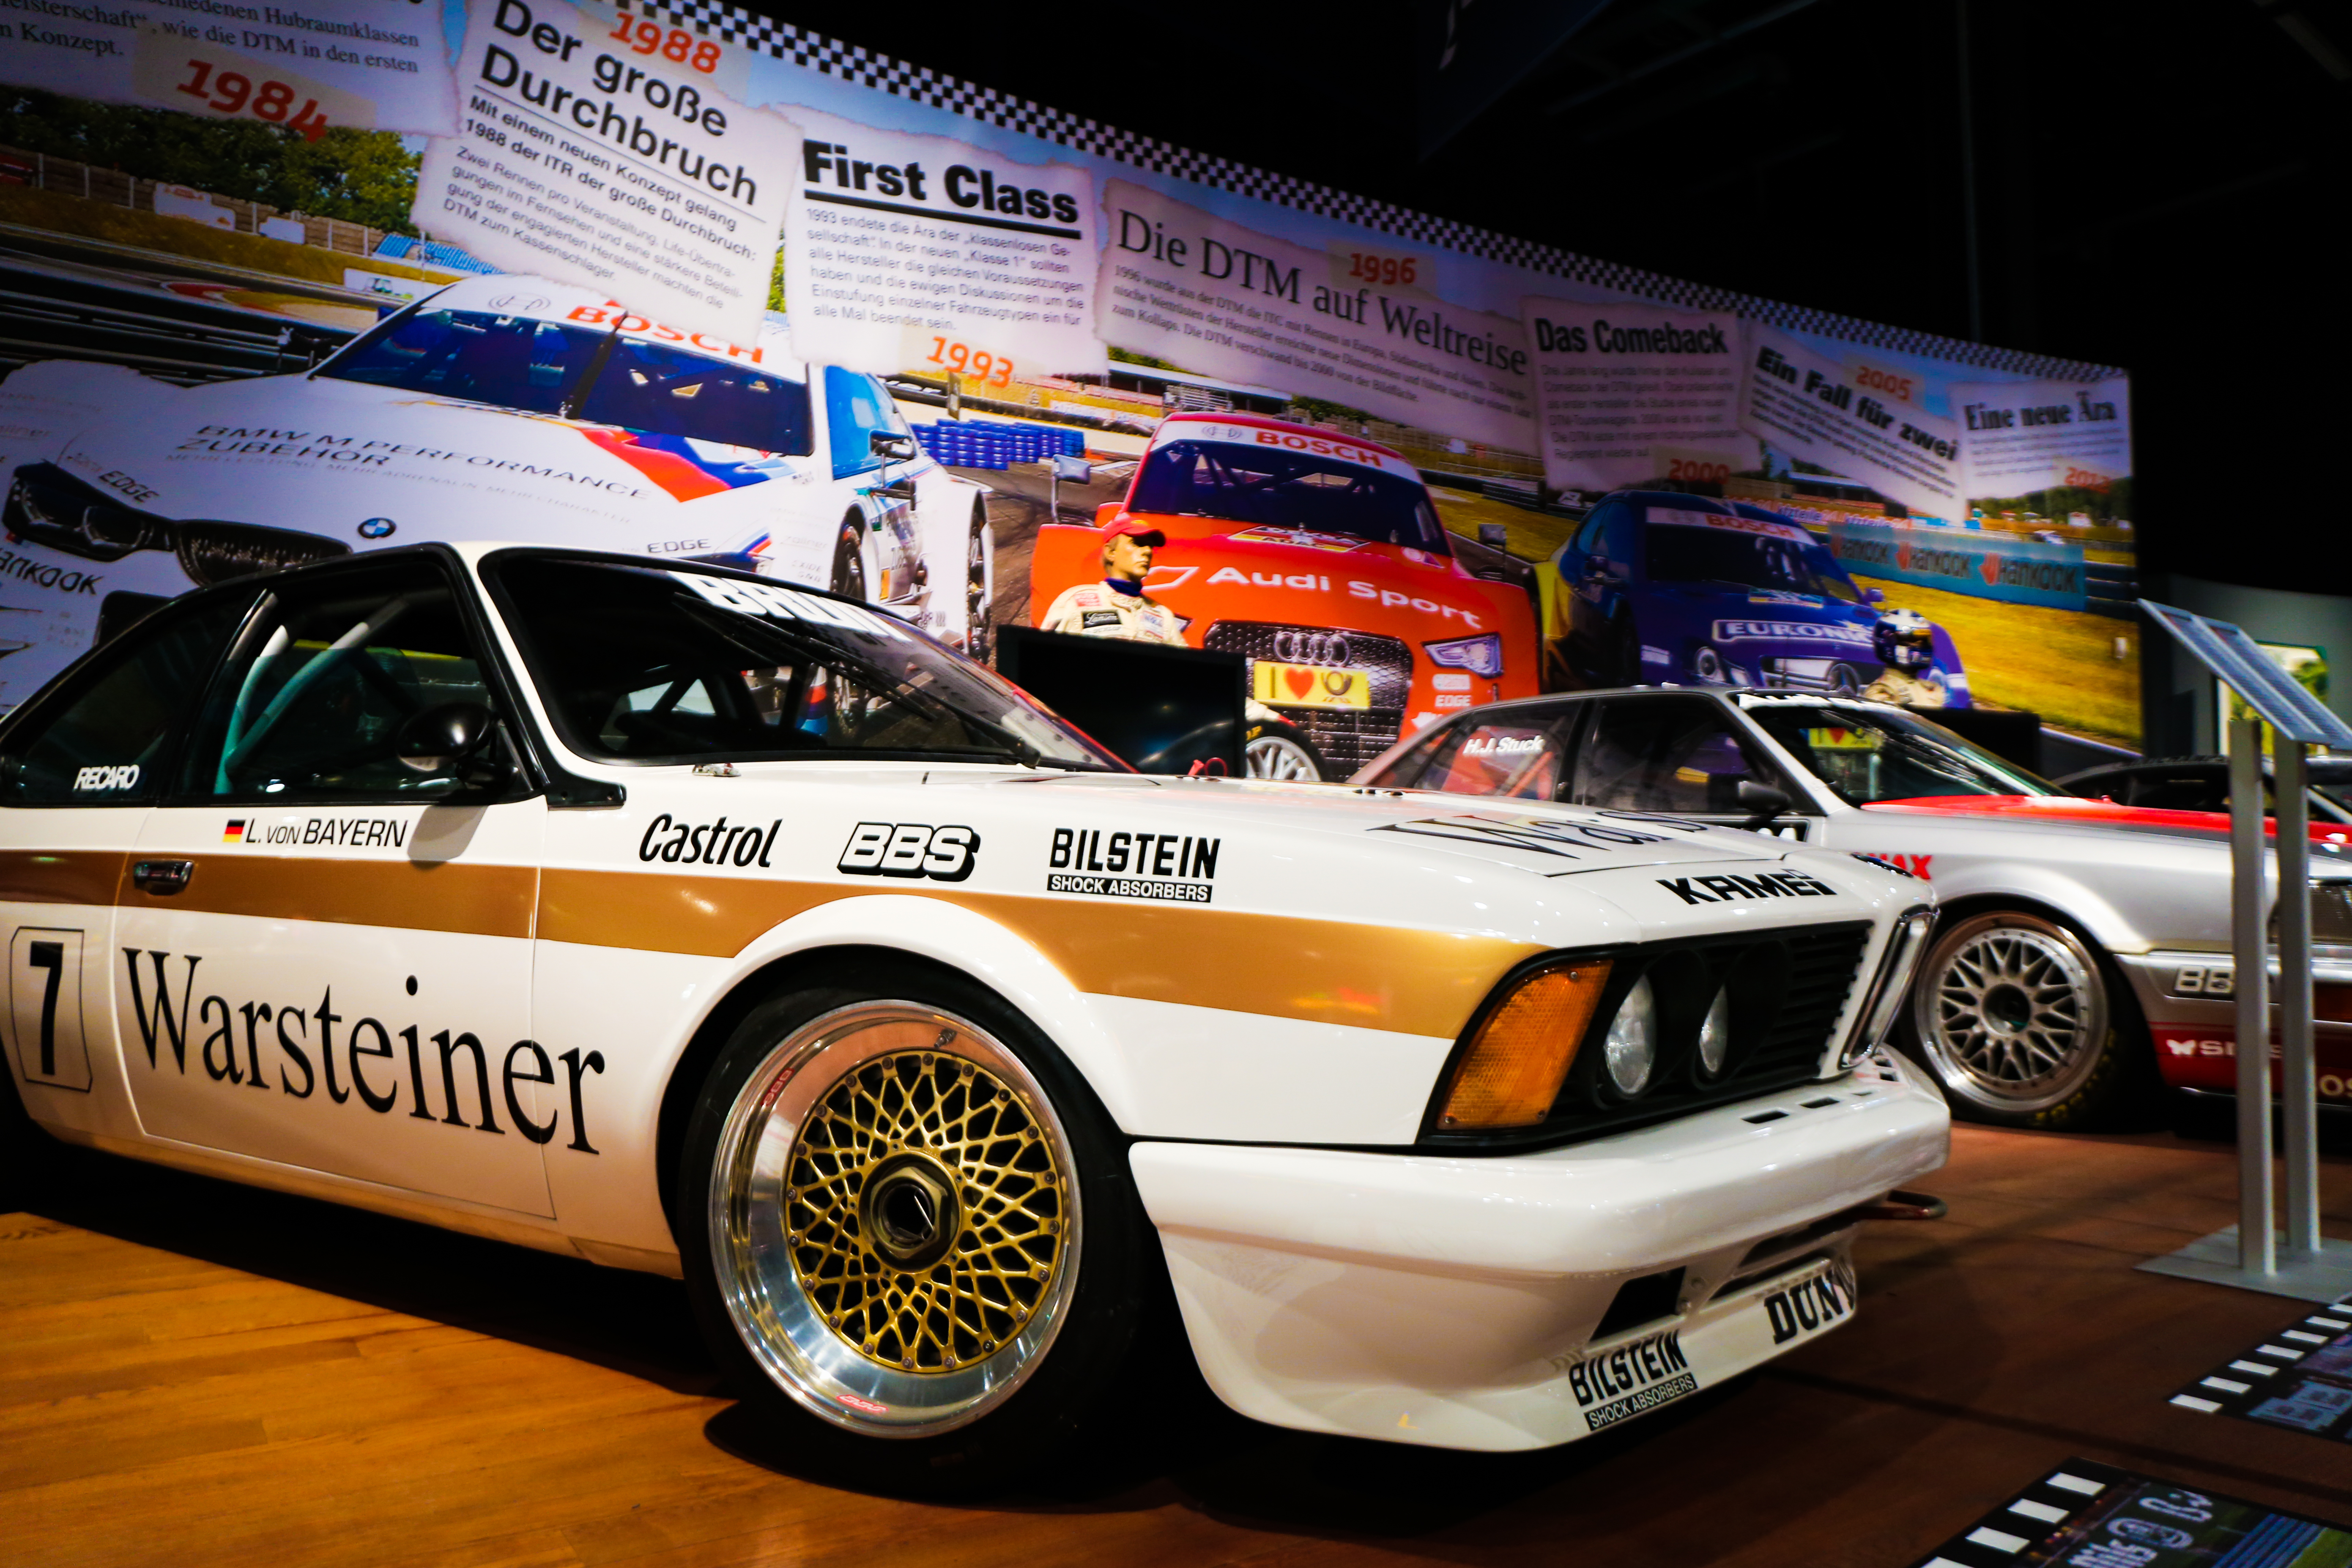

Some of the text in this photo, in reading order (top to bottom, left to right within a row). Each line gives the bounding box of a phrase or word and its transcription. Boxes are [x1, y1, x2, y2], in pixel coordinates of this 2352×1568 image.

[20, 22, 124, 57] Konzept.
[162, 19, 419, 73] wie die DTM in den ersten
[264, 6, 419, 47] Hubraumklassen
[609, 11, 722, 74] 1988
[493, 0, 728, 137] Der große
[177, 59, 329, 143] 1984
[481, 44, 758, 206] Durchbruch
[457, 146, 489, 168] Zwei
[493, 162, 545, 193] Rennen
[547, 190, 569, 205] pro
[468, 119, 755, 260] 1988 der ITR der große Durchbruch:
[470, 96, 736, 232] Mit einem neuen Konzept gelang
[804, 139, 1078, 223] First Class
[444, 198, 478, 220] DTM
[480, 216, 509, 234] zum
[452, 166, 503, 193] gungen
[507, 190, 523, 202] im
[527, 196, 594, 233] Fernsehen
[598, 231, 622, 246] und
[624, 242, 650, 259] eine
[807, 208, 836, 224] 1993
[841, 216, 886, 231] endete
[890, 222, 909, 234] die
[939, 230, 960, 241] der
[447, 183, 723, 309] gung der engagierten Hersteller machten die
[809, 249, 832, 260] alle
[838, 252, 900, 268] Hersteller
[905, 261, 924, 273] die
[928, 265, 979, 278] gleichen
[1349, 252, 1417, 286] 1996
[814, 306, 837, 317] alle
[842, 306, 865, 320] Mal
[871, 313, 923, 326] beendet
[1119, 209, 1528, 376] Die DTM auf Weltreise
[565, 306, 764, 364] BOSCH
[1534, 317, 1729, 354] Das Comeback
[926, 336, 1014, 389] 1993
[1855, 366, 1914, 401] 2005
[1755, 346, 1798, 385] Ein
[1803, 368, 1852, 411] Fall
[1856, 396, 1896, 430] für
[1898, 421, 1960, 461] zwei
[1964, 402, 2014, 431] Eine
[2020, 403, 2072, 427] neue
[176, 438, 391, 466] ZUBEHÖR
[197, 425, 652, 500] BMW M PERFORMANCE
[1256, 431, 1384, 468] BOSCH
[1669, 458, 1730, 485] 2000
[99, 470, 160, 504] EDGE
[647, 538, 712, 554] EDGE
[1704, 514, 1796, 539] BOSCH
[1207, 567, 1484, 630] Audi Sport
[1435, 694, 1472, 707] EDGE
[1463, 734, 1546, 754] H.J. Stuck
[73, 764, 140, 791] RECARO
[246, 818, 409, 847] L. VON BAYERN
[639, 813, 783, 868] Castrol
[837, 821, 980, 882] BBS
[1049, 828, 1221, 879] BILSTEIN
[1051, 875, 1209, 902] SHOCK ABSORBERS
[1656, 869, 1837, 905] KAMEI
[2174, 966, 2237, 996] BB
[30, 941, 64, 1075] 7
[122, 947, 606, 1155] Warsteiner
[1568, 1329, 1688, 1407] BILSTEIN
[1589, 1375, 1695, 1429] SHOCK ABSORBERS
